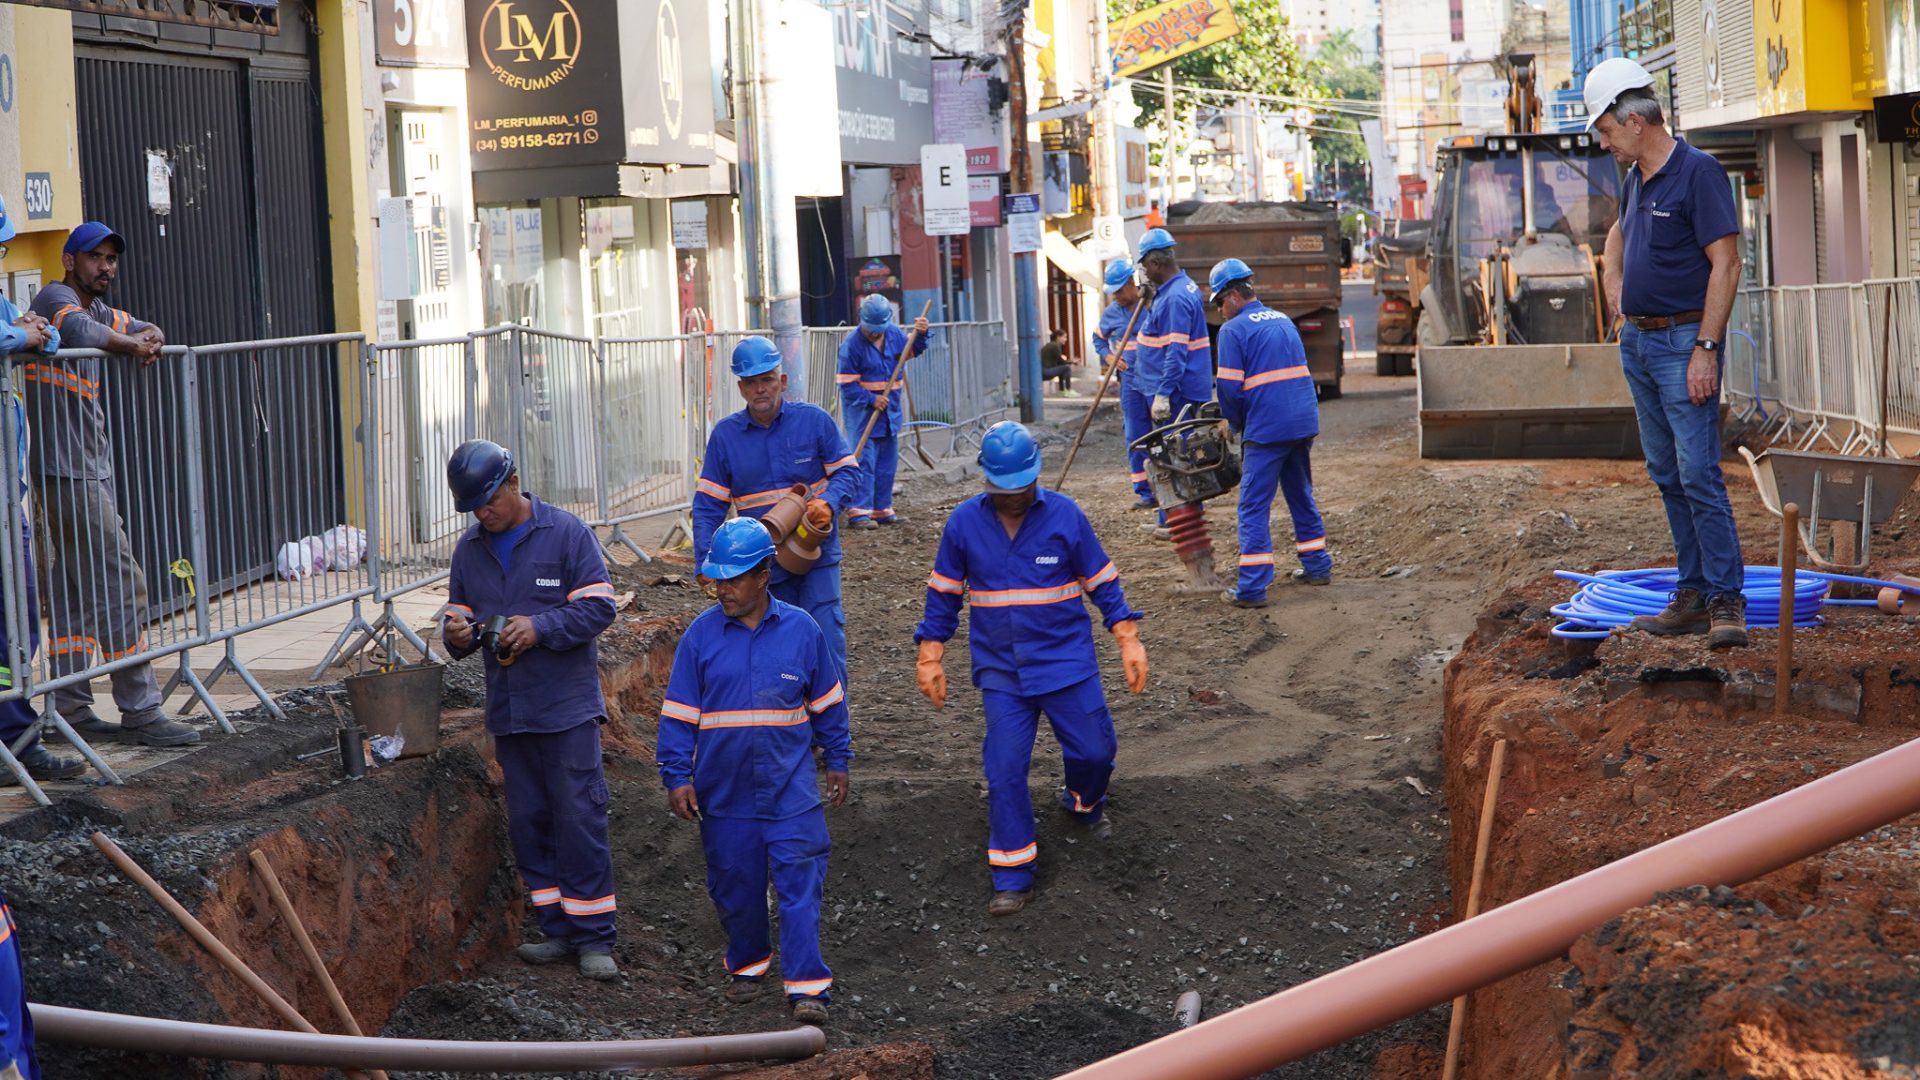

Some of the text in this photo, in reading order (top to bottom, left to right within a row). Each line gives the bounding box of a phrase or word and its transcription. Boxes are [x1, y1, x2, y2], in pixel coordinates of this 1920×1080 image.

[495, 3, 572, 62] LM
[492, 64, 574, 90] PERFUMARIA
[476, 134, 580, 152] (34) 99158-6271
[940, 166, 951, 186] E
[27, 179, 50, 212] 530
[515, 214, 540, 233] BLUE
[1105, 225, 1112, 236] E
[536, 578, 560, 586] CODAU
[781, 673, 799, 681] CODAU
